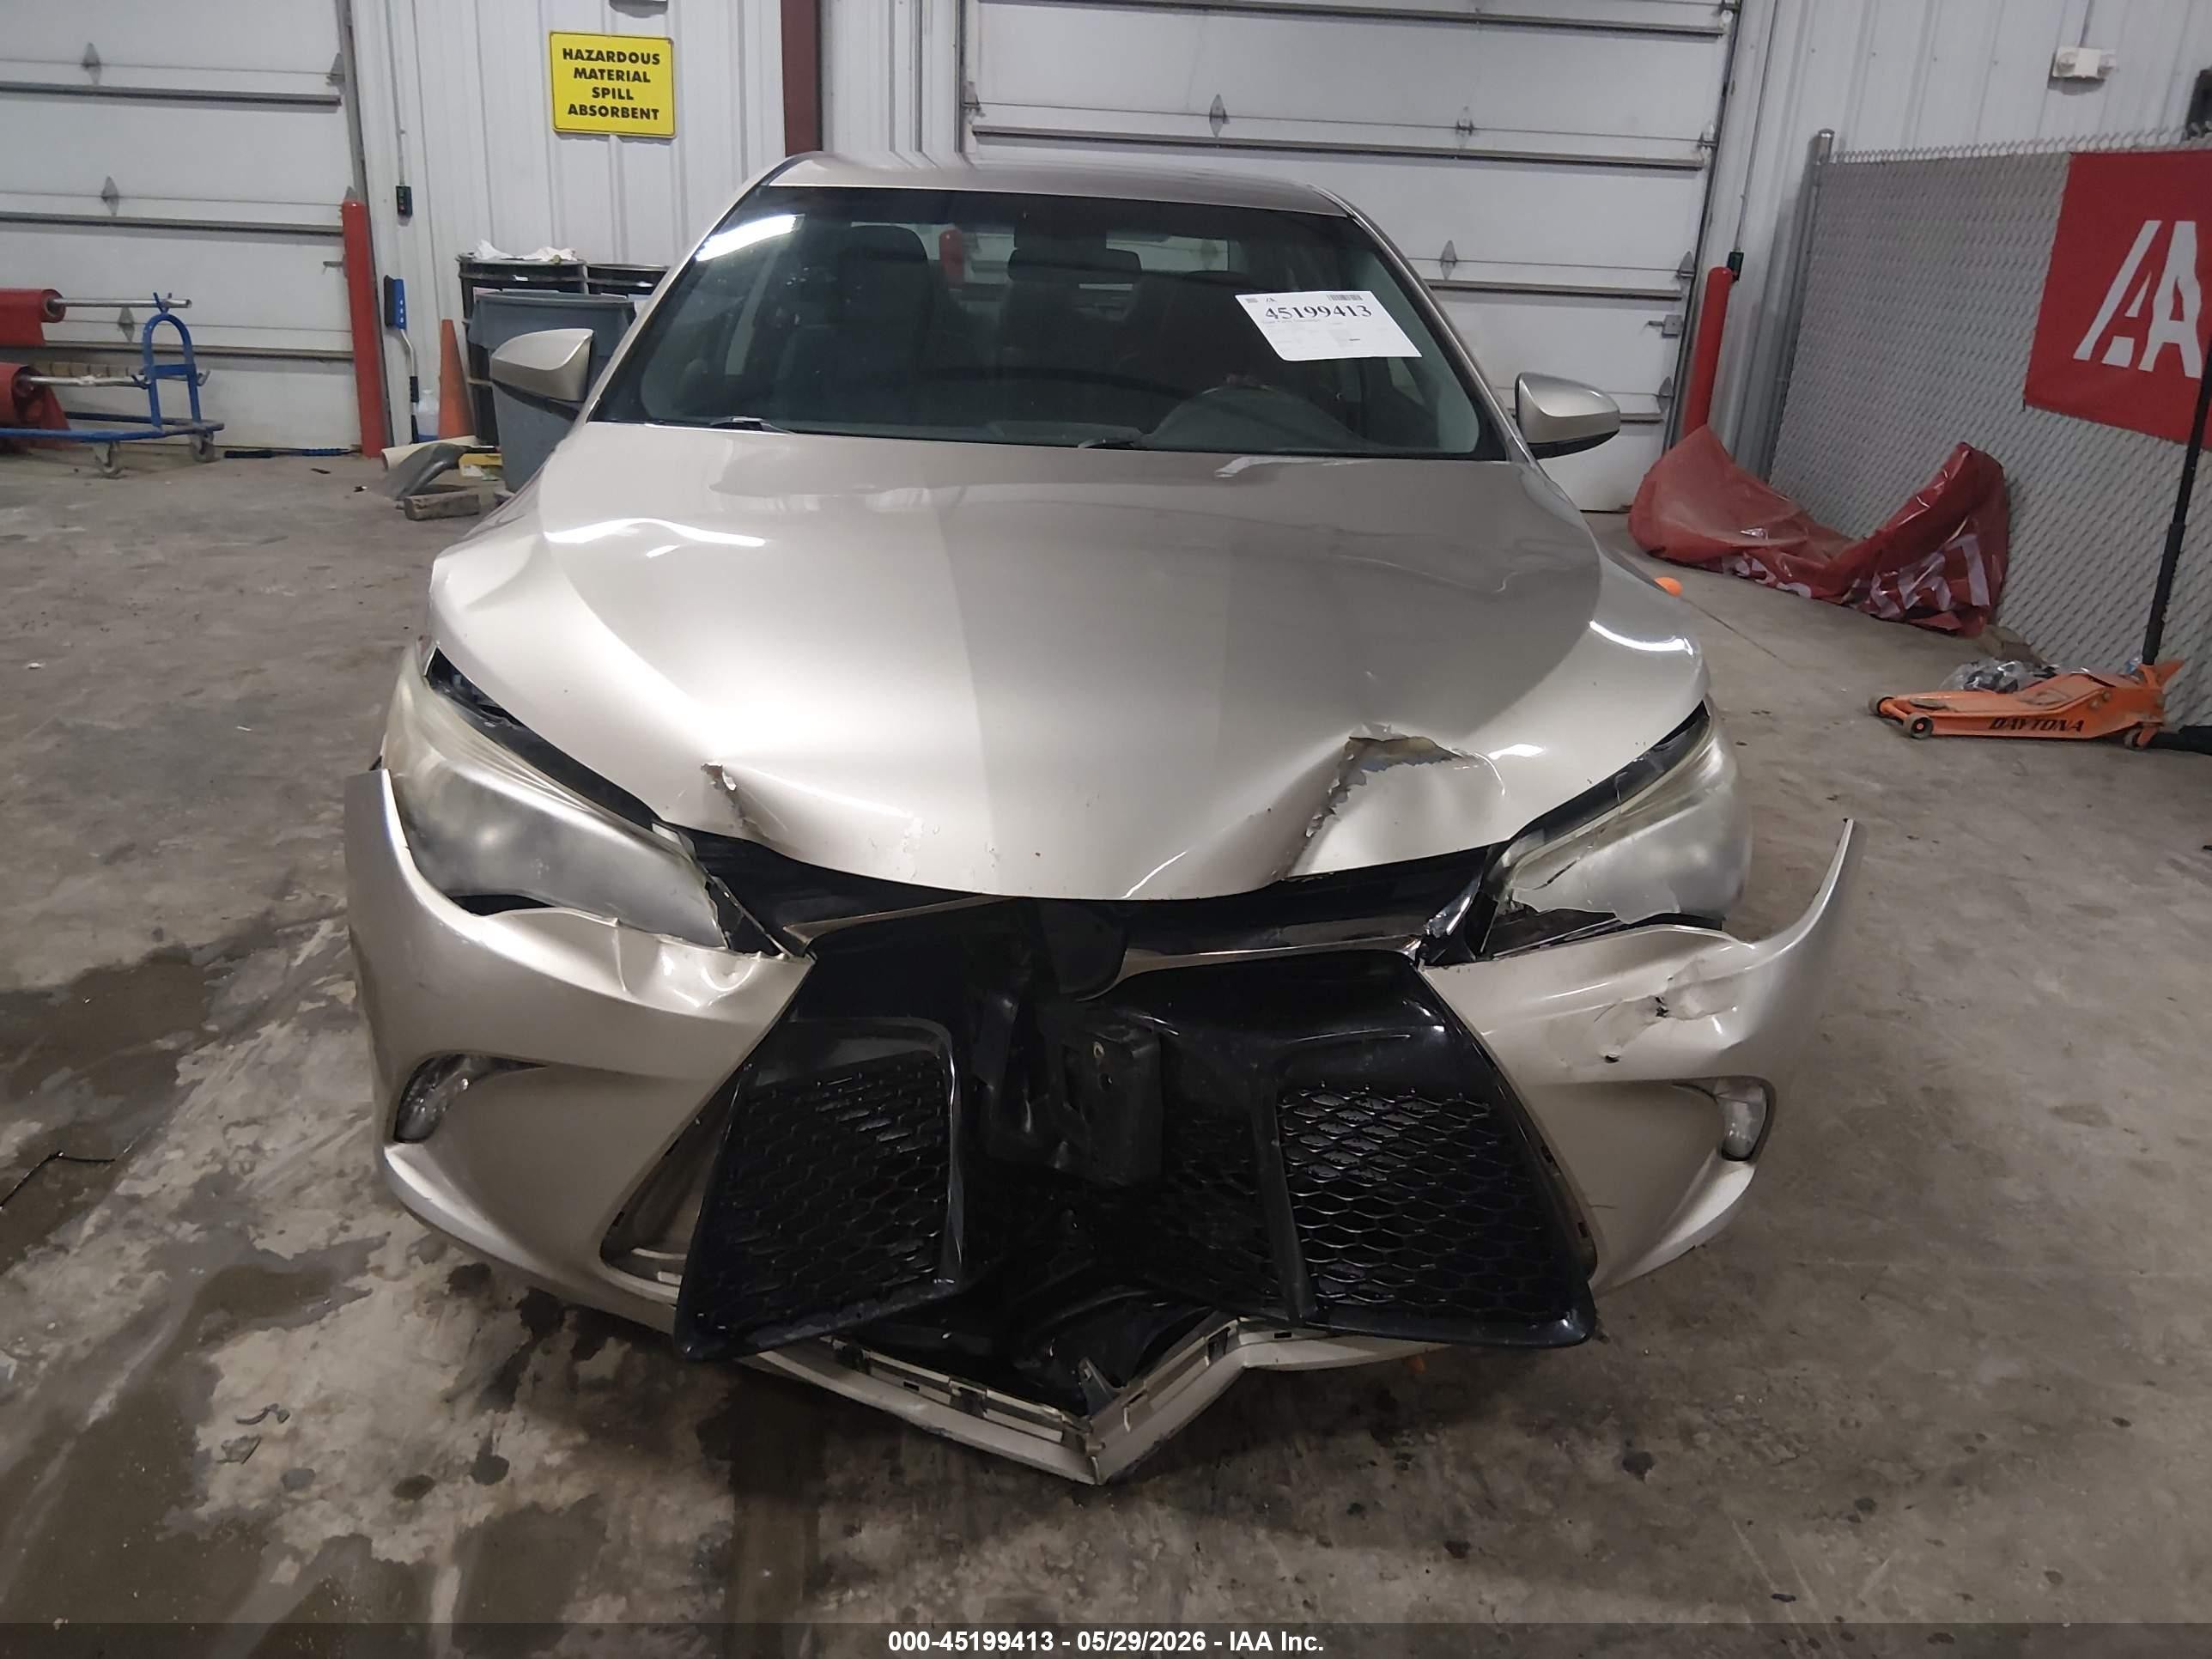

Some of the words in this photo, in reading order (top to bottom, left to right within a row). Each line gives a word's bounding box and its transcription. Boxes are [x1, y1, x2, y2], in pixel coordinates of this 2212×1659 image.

[562, 48, 660, 65] HAZARDOUS
[574, 67, 651, 83] MATERIAL
[592, 87, 634, 100] SPILL
[568, 104, 659, 120] ABSORBENT
[1265, 305, 1372, 319] 45199413
[1989, 717, 2084, 732] DAYTONA
